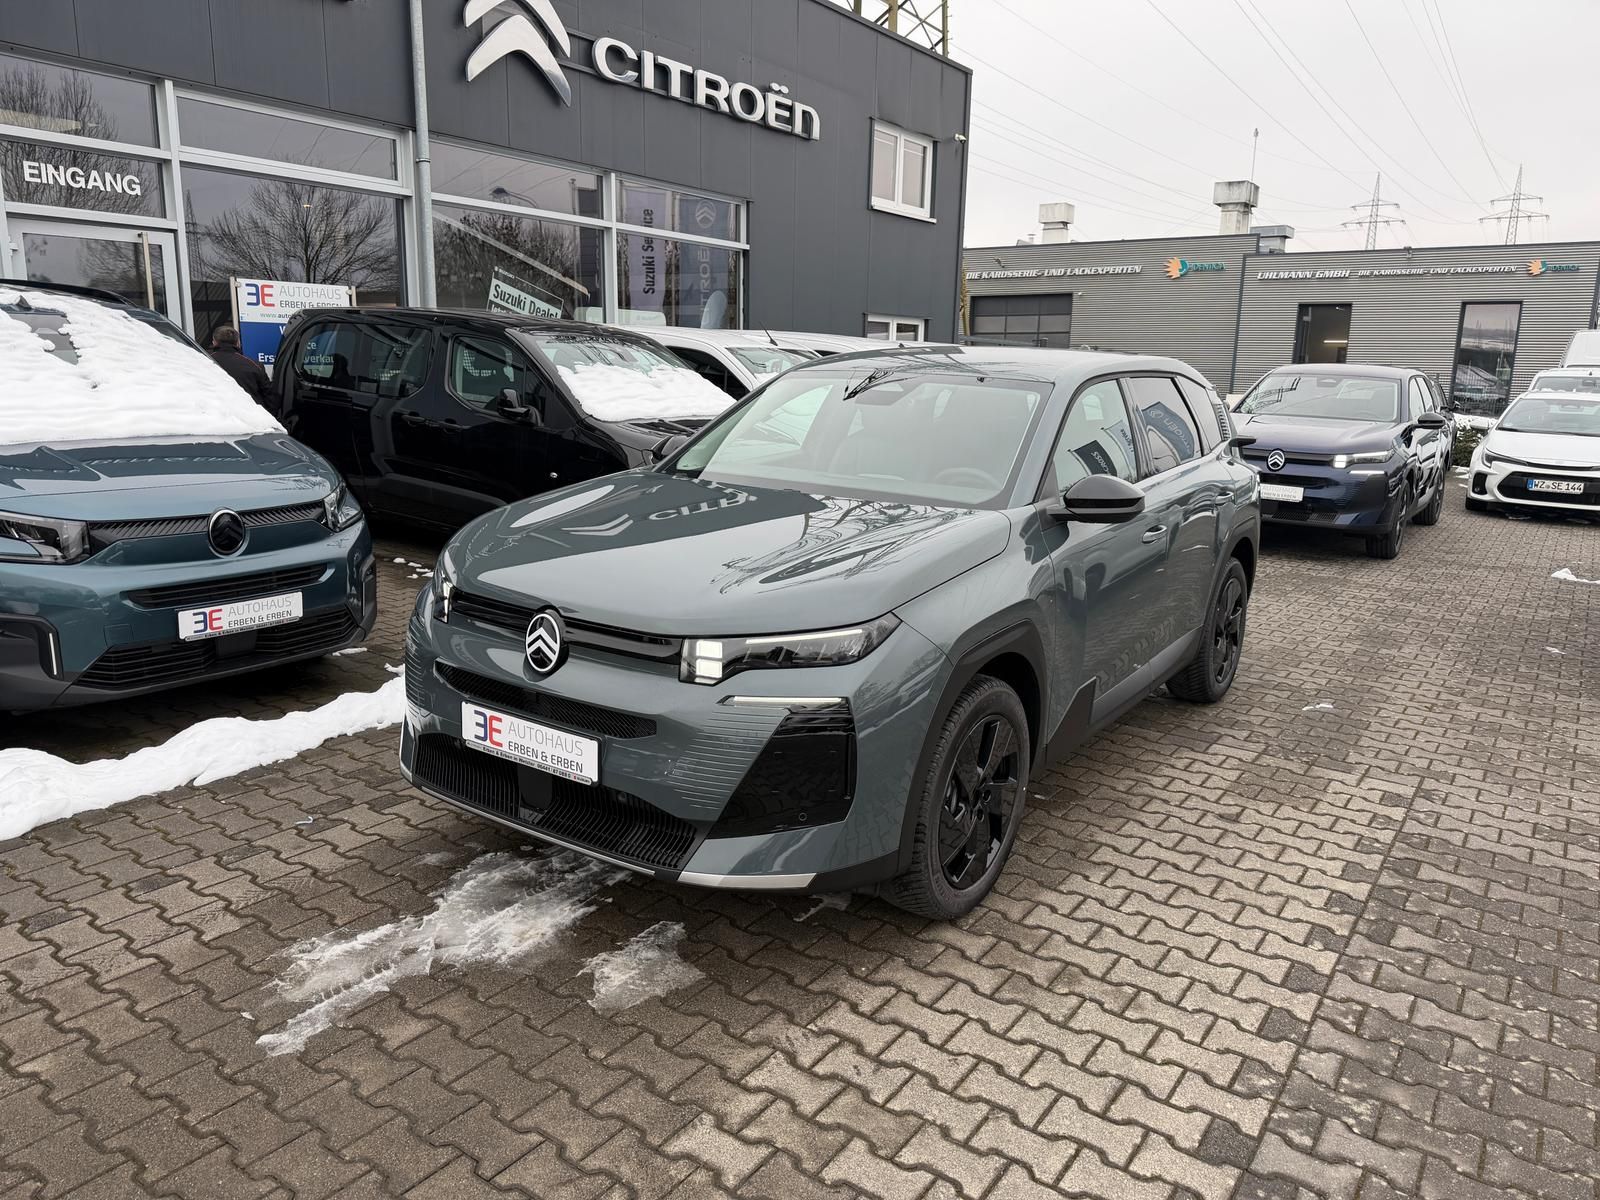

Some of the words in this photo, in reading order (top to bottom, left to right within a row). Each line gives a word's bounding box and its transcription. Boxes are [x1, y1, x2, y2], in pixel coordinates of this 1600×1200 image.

[591, 36, 820, 141] CITROËN
[22, 160, 141, 196] EINGANG
[641, 208, 655, 252] Seice
[641, 255, 656, 295] Suzuki
[966, 271, 980, 280] DIE
[1044, 267, 1065, 277] UND
[1066, 265, 1142, 276] LACKEXPERTEN
[1256, 270, 1312, 280] UHLMANN
[1315, 269, 1350, 279] GMBH
[1450, 265, 1517, 274] LACKEXPERTEN
[280, 285, 342, 300] AUTOHAUS
[280, 300, 306, 309] ERBEN
[493, 284, 526, 312] Suzuki
[1534, 480, 1546, 489] WZ
[1551, 481, 1563, 490] SE
[1565, 483, 1582, 491] 144
[228, 596, 292, 617] AUTOHAUS
[228, 616, 256, 628] ERBEN
[257, 614, 264, 623] &
[266, 609, 292, 621] ERBEN
[508, 721, 583, 757] AUTOHAUS
[508, 740, 539, 760] ERBEN
[541, 751, 548, 762] &
[551, 754, 583, 774] ERBEN
